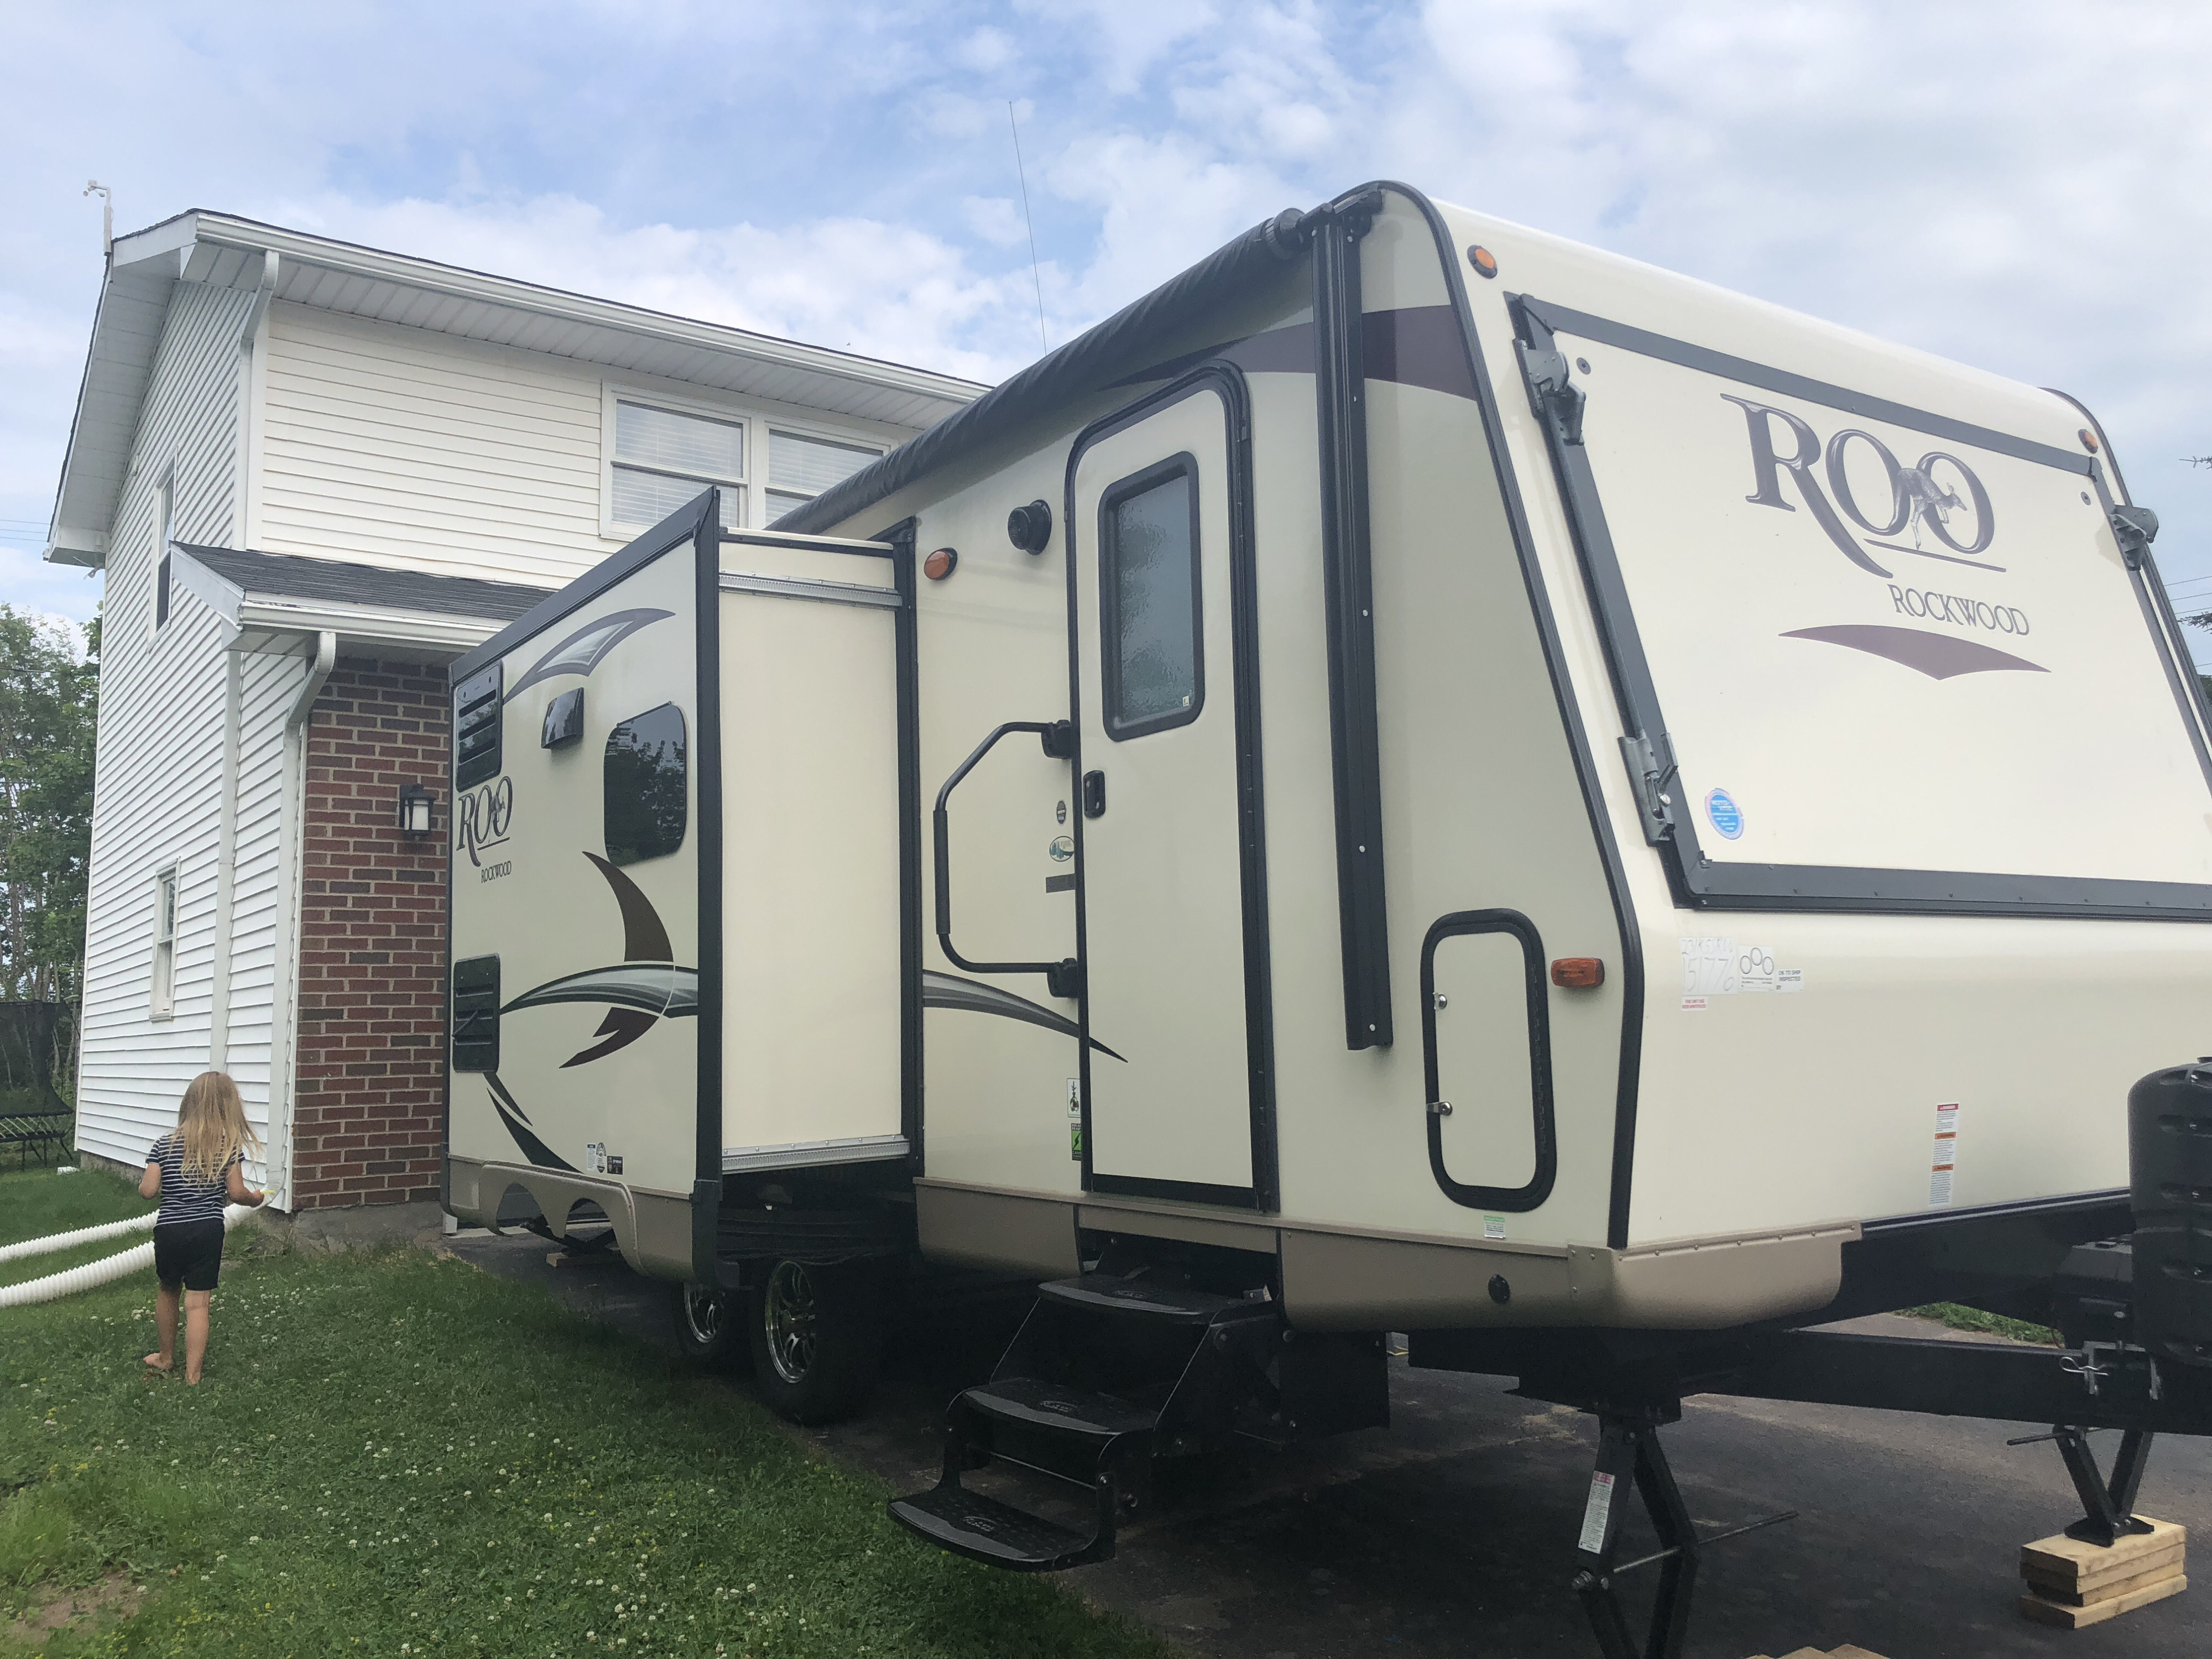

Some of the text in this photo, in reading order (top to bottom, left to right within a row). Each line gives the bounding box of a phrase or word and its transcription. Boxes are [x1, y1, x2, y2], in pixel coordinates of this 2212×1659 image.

[1720, 393, 1995, 579] ROO
[1887, 583, 2030, 636] ROCKWOOD
[456, 776, 513, 867] ROO
[481, 860, 512, 884] ROCKWOOD
